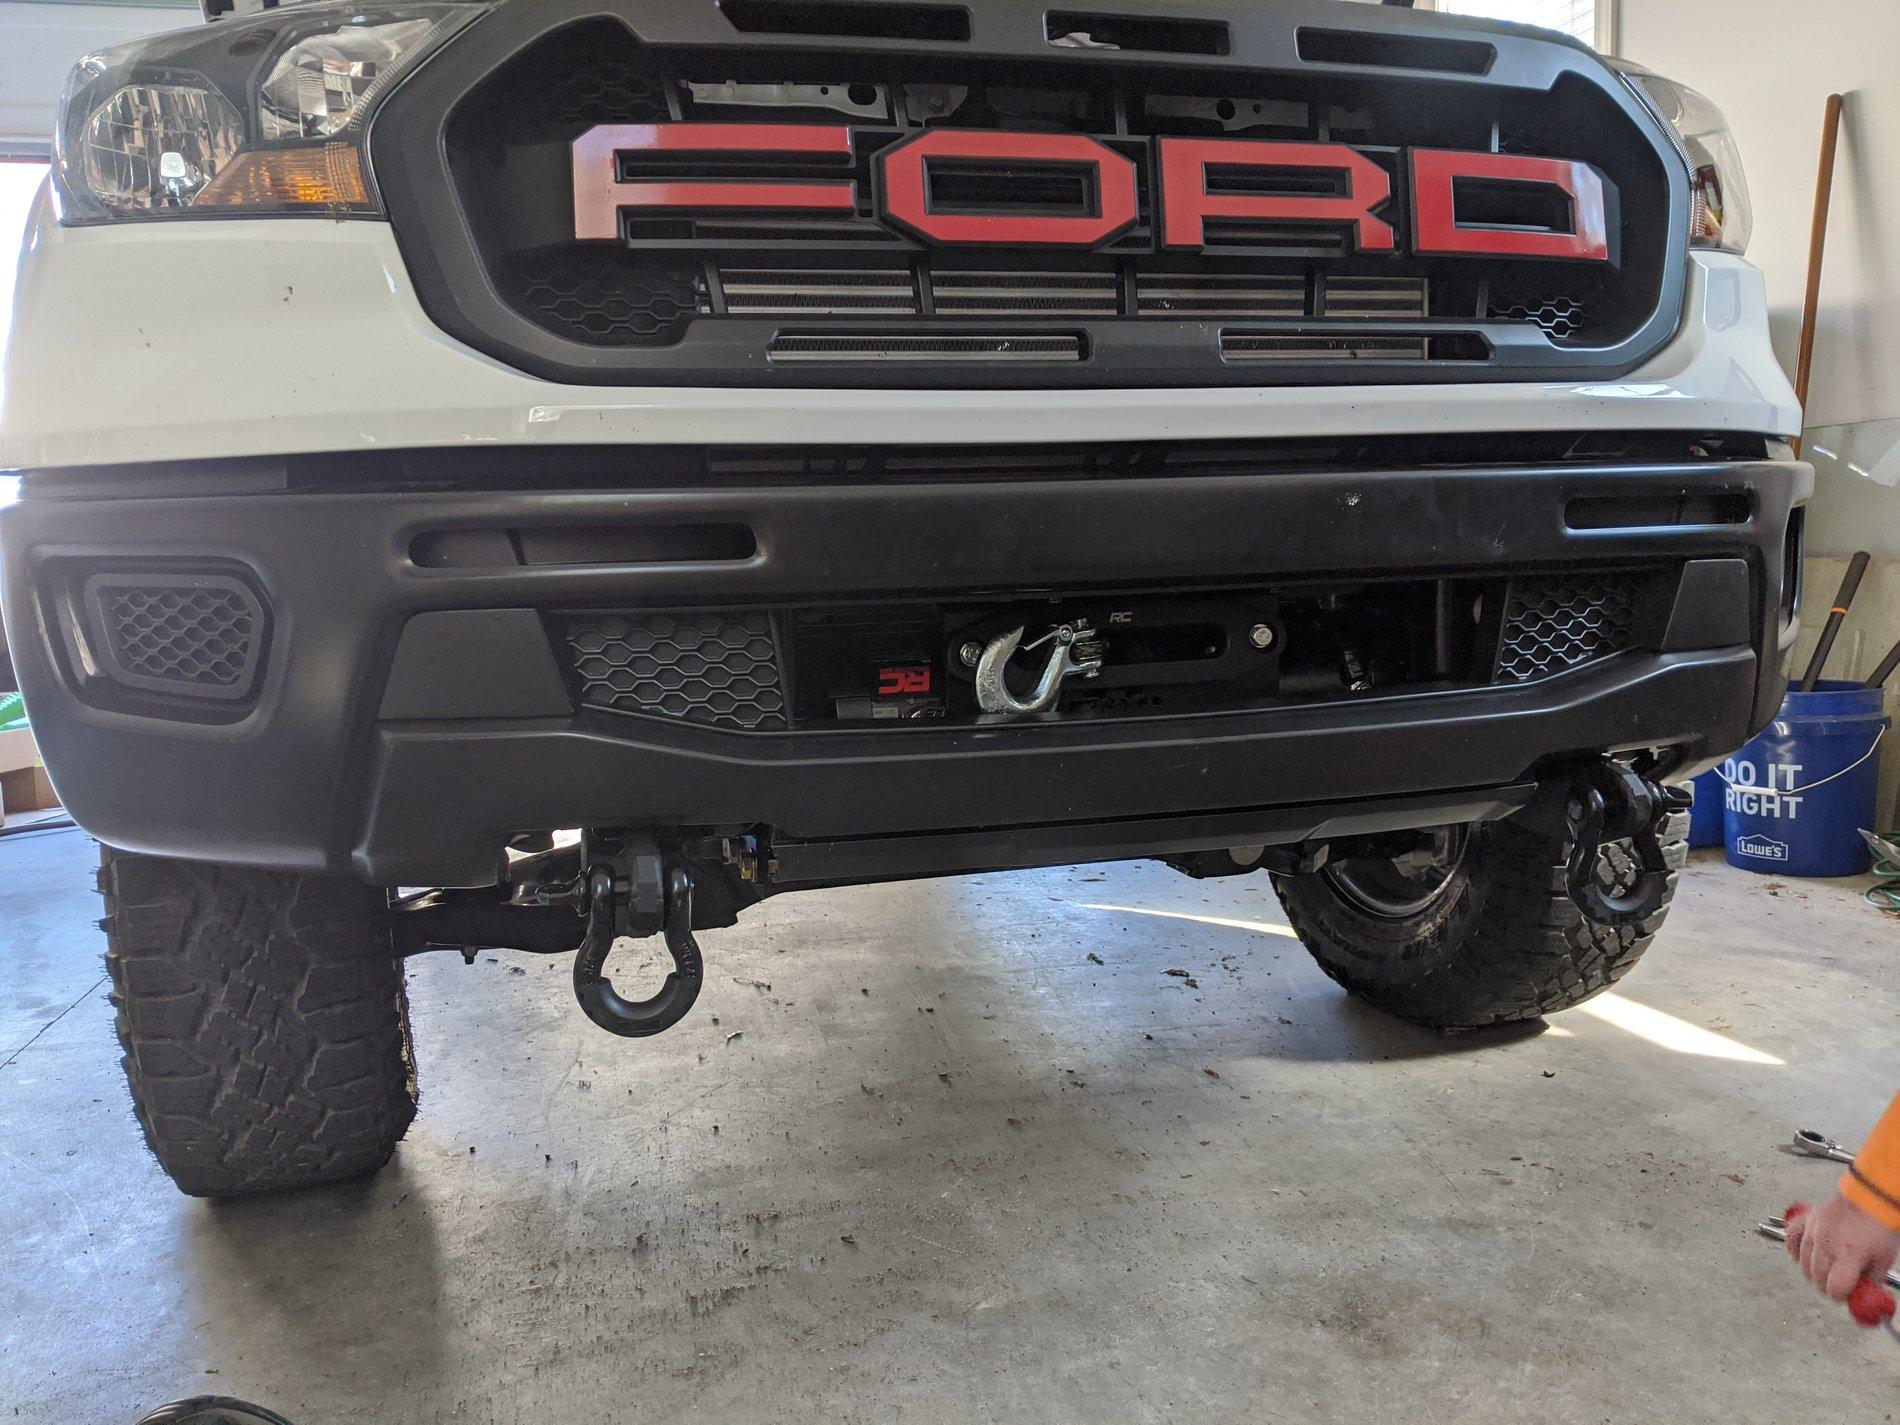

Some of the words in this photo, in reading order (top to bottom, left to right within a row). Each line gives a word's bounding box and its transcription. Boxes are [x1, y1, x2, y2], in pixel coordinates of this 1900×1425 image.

[572, 123, 1608, 263] FORD
[1109, 611, 1133, 624] RC
[1724, 758, 1756, 786] DO
[1768, 763, 1803, 790] IT
[1725, 787, 1803, 819] RIGHT
[1741, 840, 1783, 858] LOWE'S
